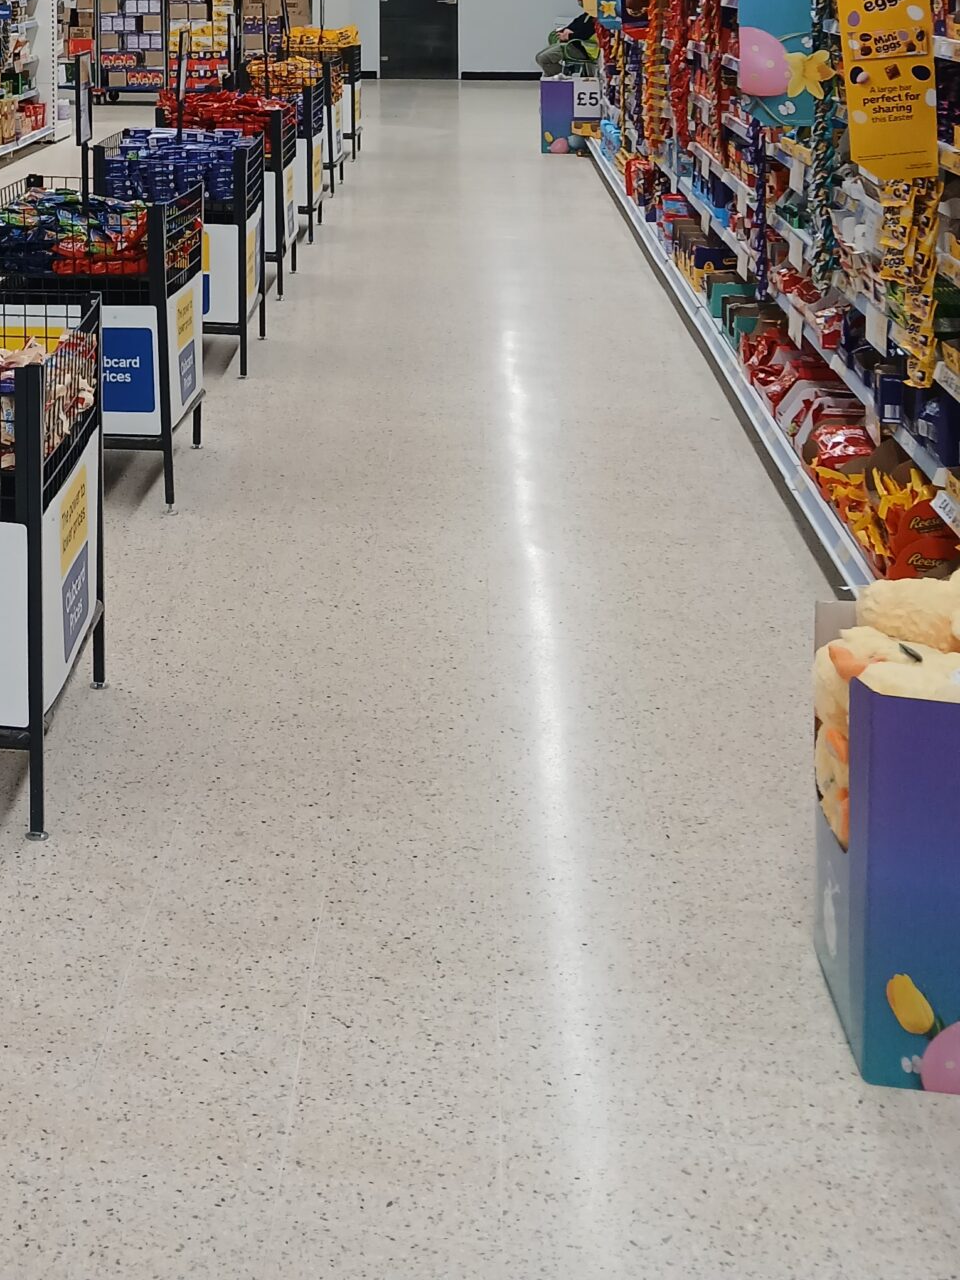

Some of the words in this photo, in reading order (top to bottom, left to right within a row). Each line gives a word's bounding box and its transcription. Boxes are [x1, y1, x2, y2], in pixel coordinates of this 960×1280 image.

[873, 31, 898, 45] Mini
[875, 41, 902, 53] eggs
[878, 85, 898, 94] large
[577, 91, 599, 107] £5
[862, 93, 902, 107] perfect
[905, 91, 921, 101] for
[872, 104, 913, 115] sharing
[888, 114, 914, 122] Easter
[883, 258, 905, 268] eggs
[103, 356, 140, 368] bcard
[102, 370, 132, 383] rices
[65, 561, 86, 613] Clubcard
[69, 598, 83, 636] Prices
